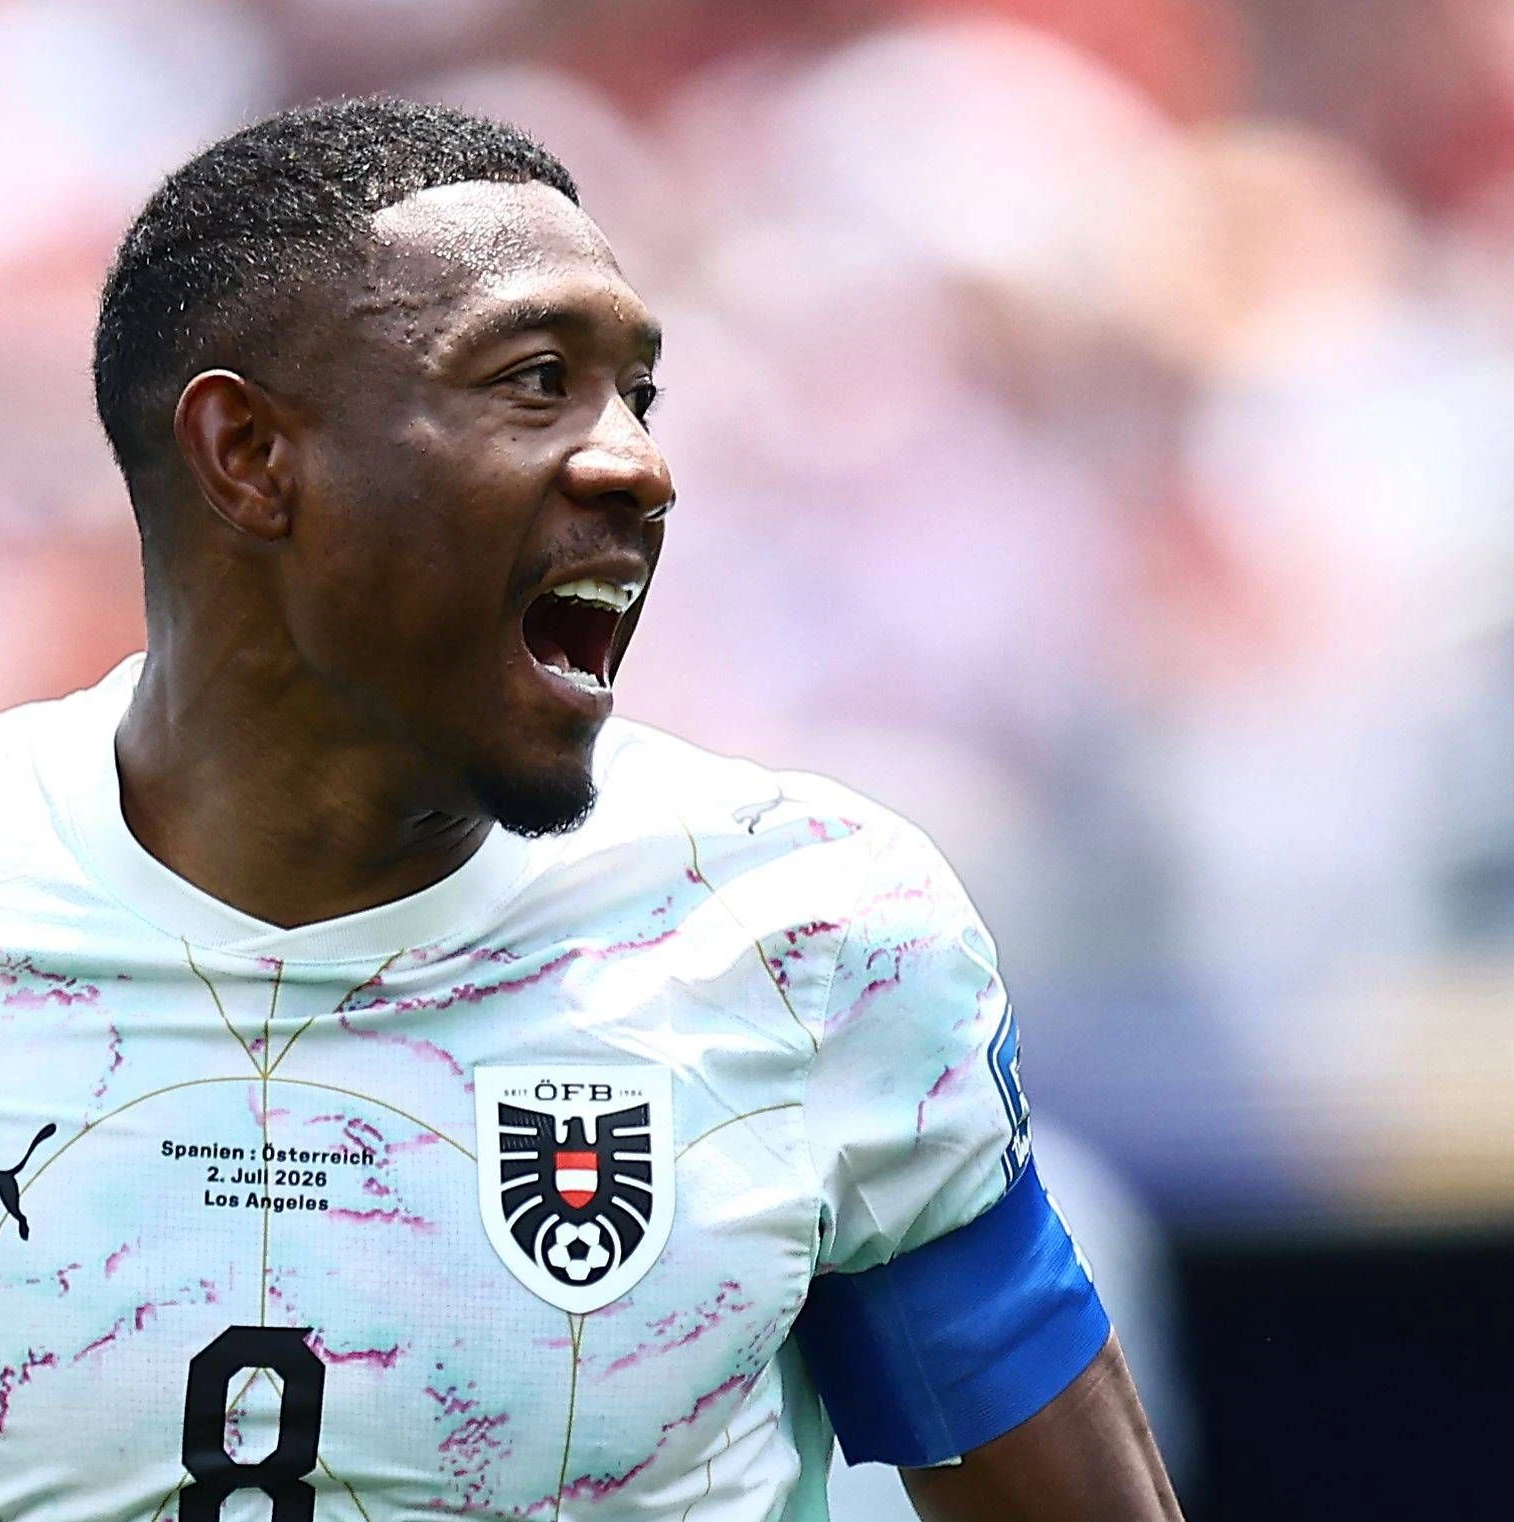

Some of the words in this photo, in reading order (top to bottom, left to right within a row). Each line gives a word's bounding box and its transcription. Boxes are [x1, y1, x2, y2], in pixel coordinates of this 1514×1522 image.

[534, 1079, 612, 1101] ÖFB
[161, 1140, 244, 1160] Spanien
[262, 1142, 373, 1165] Österreich
[207, 1166, 225, 1182] 2.
[230, 1167, 268, 1184] Juli
[275, 1169, 327, 1187] 2026
[204, 1189, 238, 1207] Los
[245, 1192, 328, 1212] Angeles
